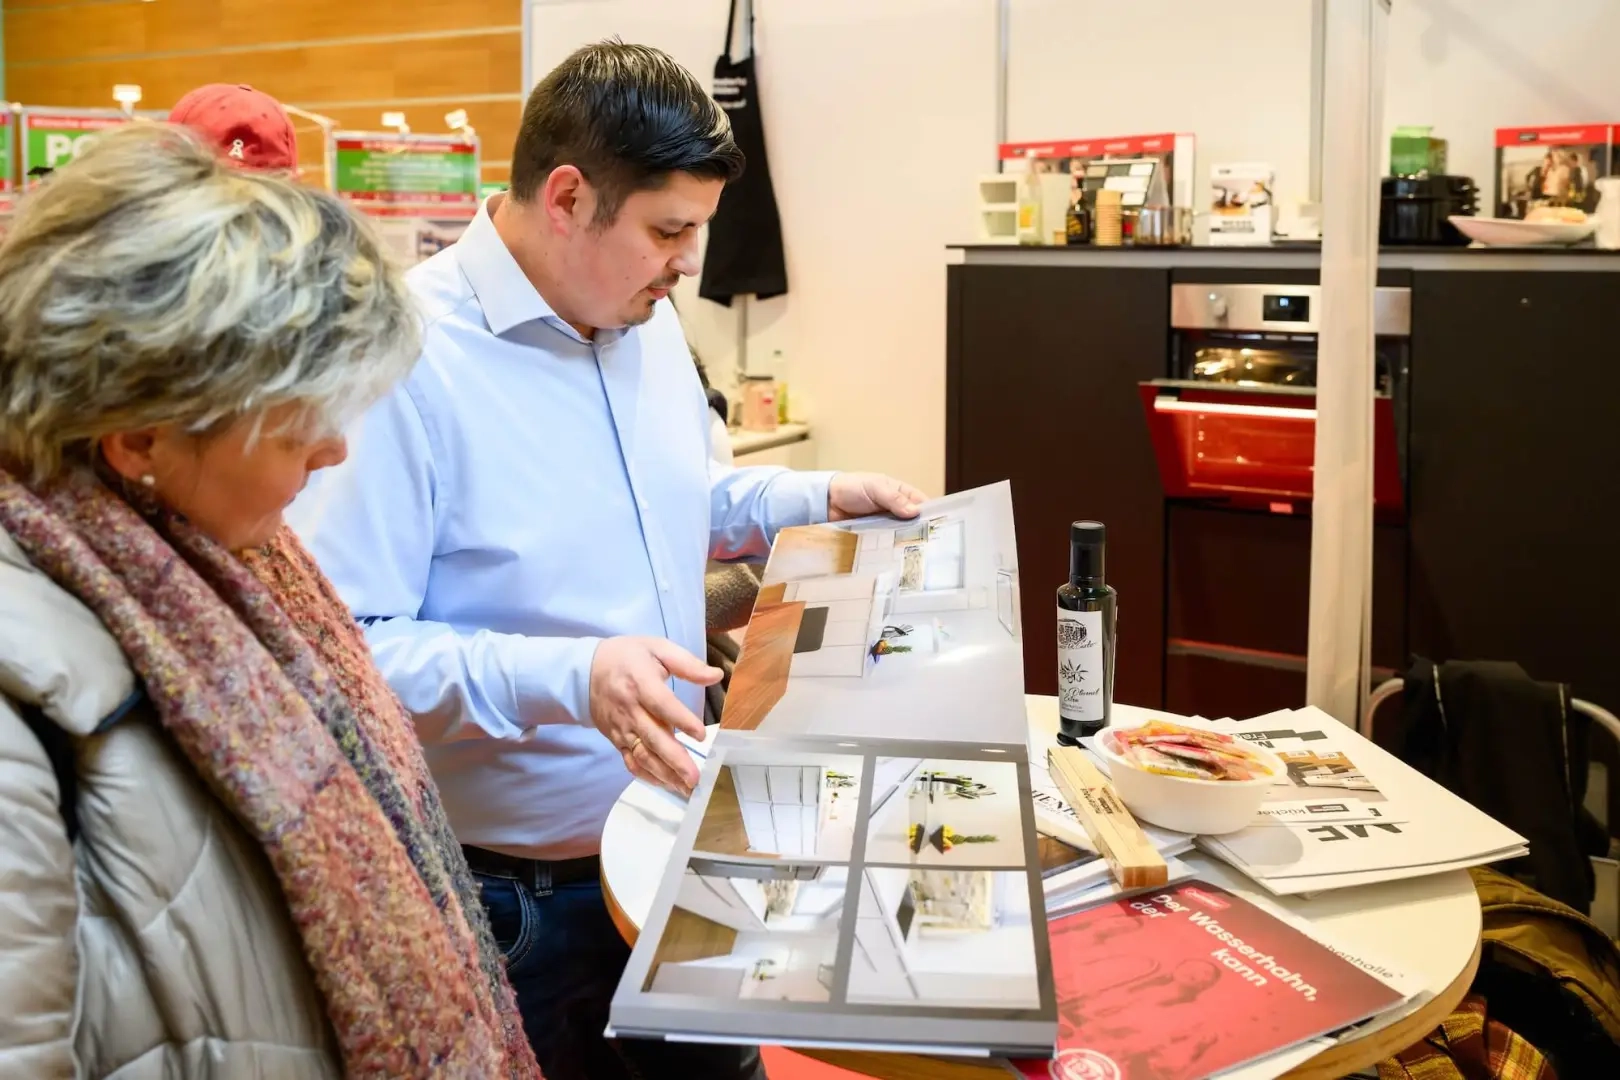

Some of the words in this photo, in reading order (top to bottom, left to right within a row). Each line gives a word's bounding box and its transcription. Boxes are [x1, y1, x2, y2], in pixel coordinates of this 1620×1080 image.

[1130, 901, 1168, 918] der
[1210, 948, 1268, 987] kann
[1152, 894, 1190, 913] Der
[1188, 911, 1318, 1002] Wasserhahn,
